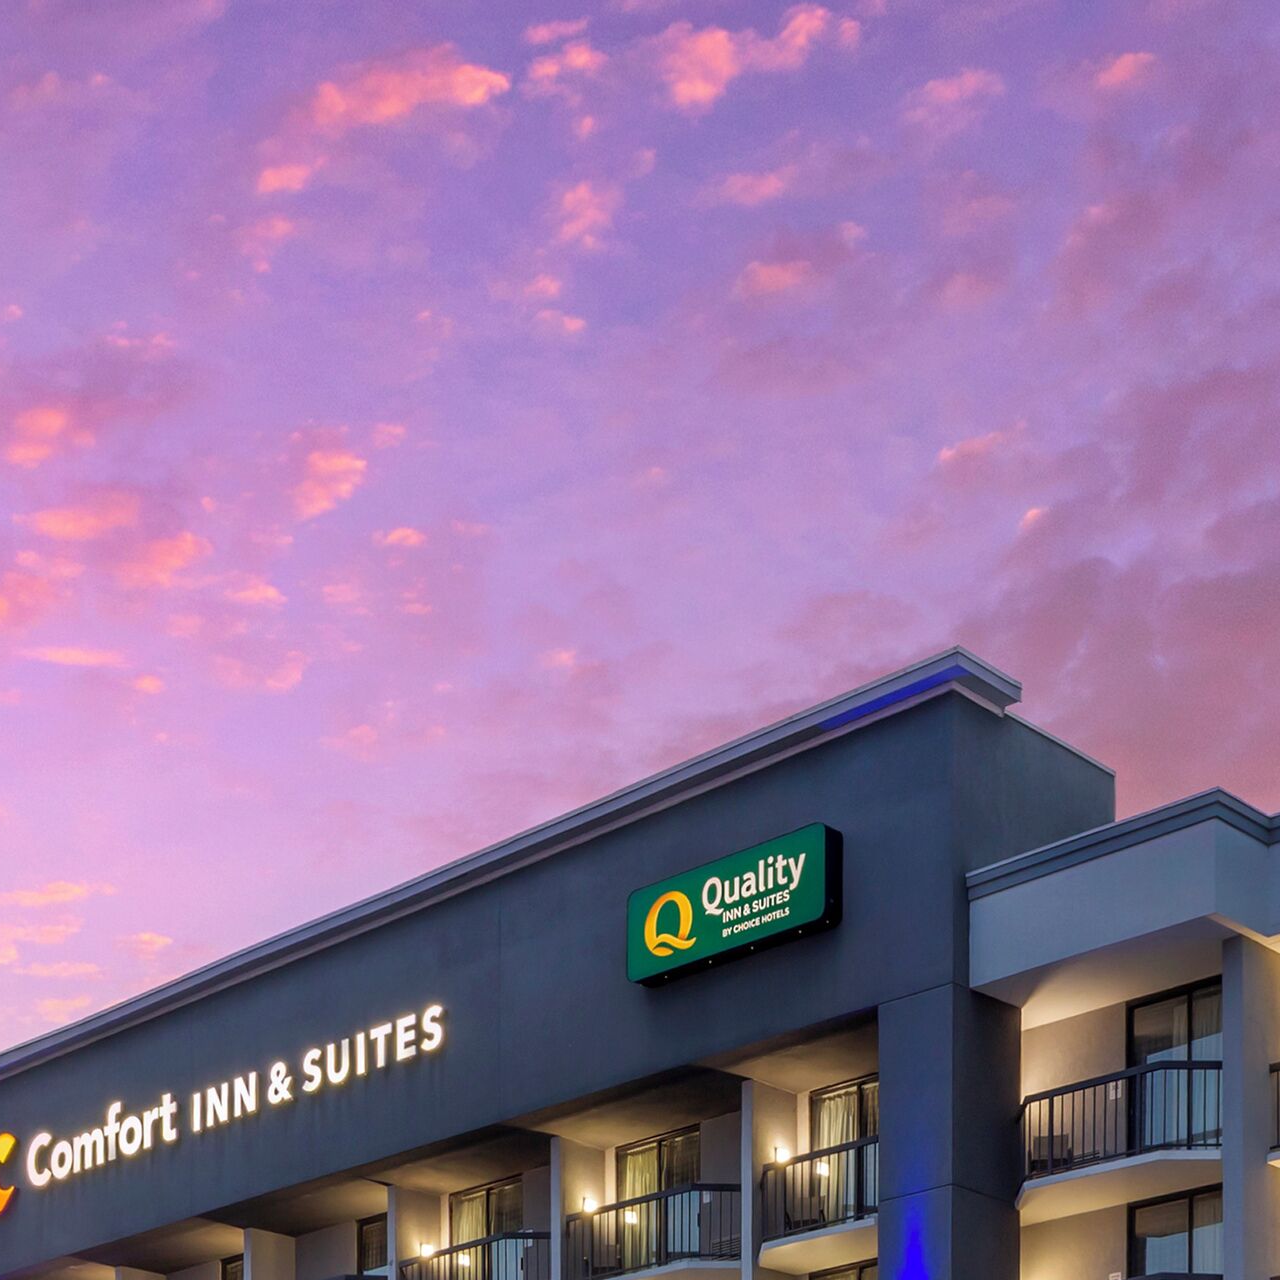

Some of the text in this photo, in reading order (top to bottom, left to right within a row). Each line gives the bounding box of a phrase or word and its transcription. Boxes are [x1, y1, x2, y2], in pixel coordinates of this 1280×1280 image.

[701, 853, 806, 915] Quality
[722, 889, 790, 923] INN & SUITES
[644, 890, 697, 957] Q
[722, 907, 790, 938] BY CHOICE HOTELS
[26, 1093, 177, 1187] Comfort
[192, 1071, 258, 1132] INN
[267, 1061, 292, 1105] &
[302, 1004, 444, 1092] SUITES
